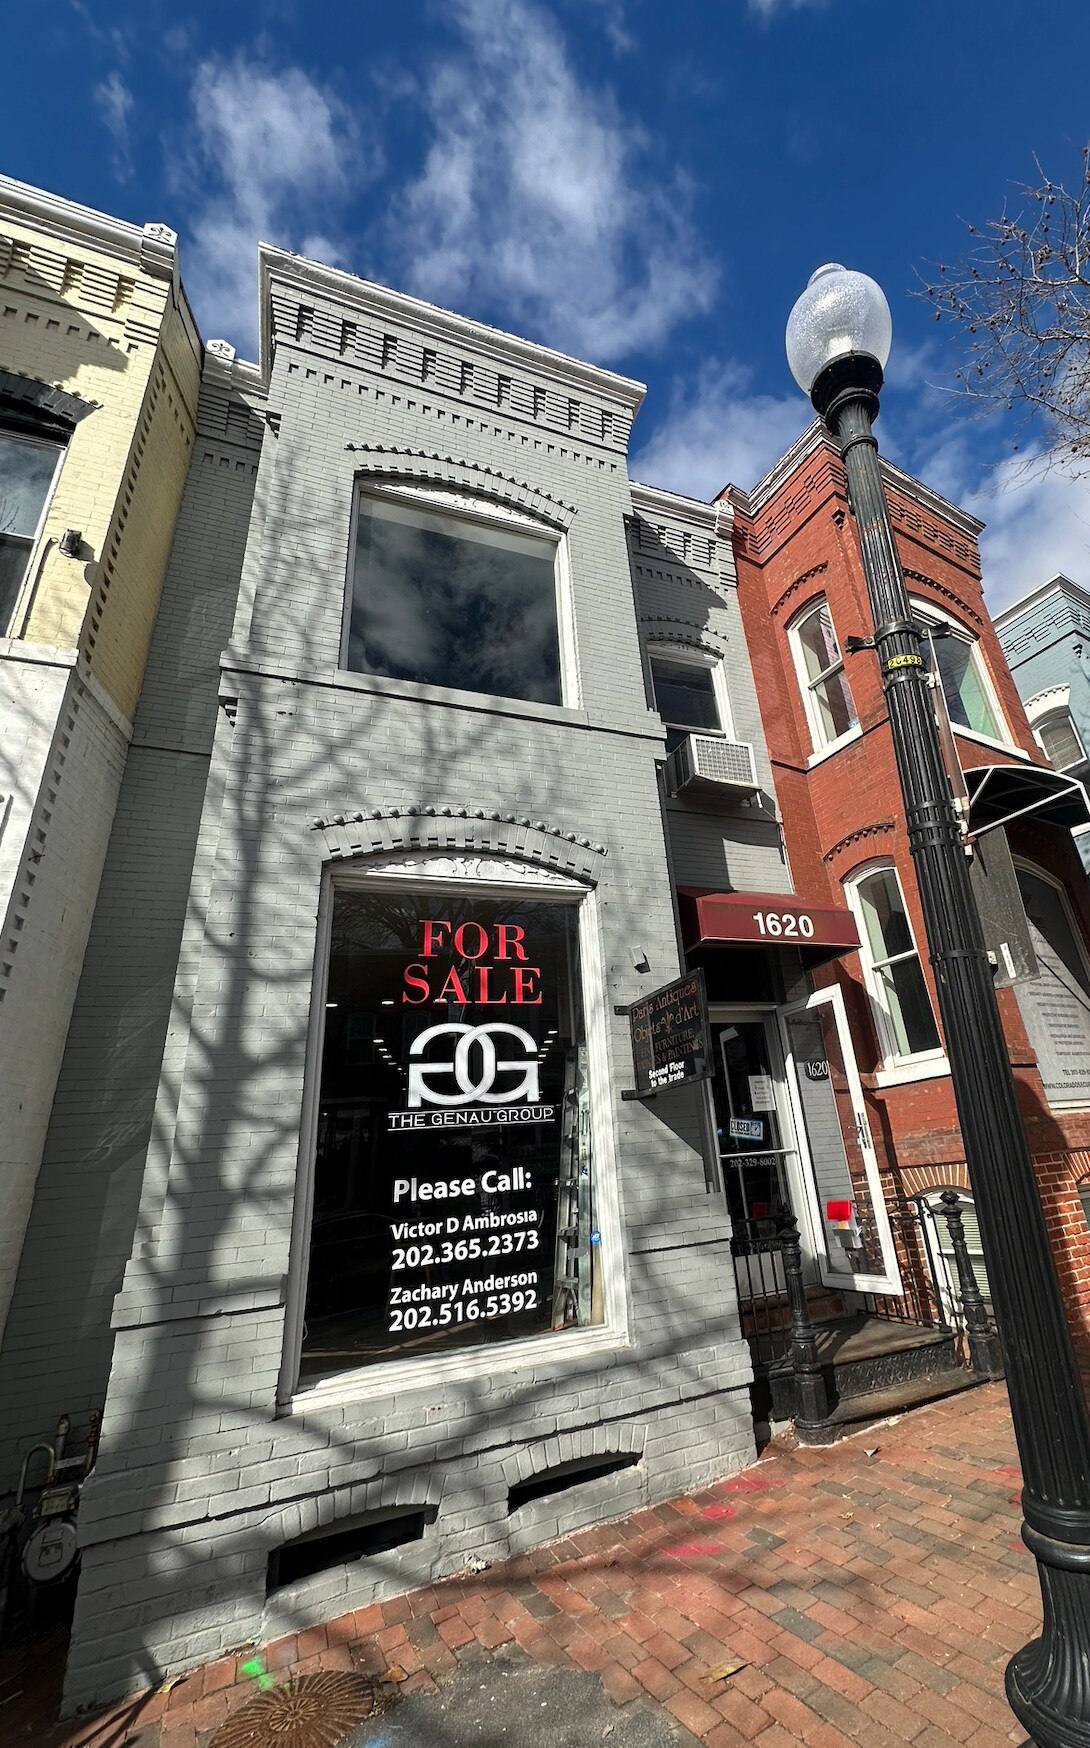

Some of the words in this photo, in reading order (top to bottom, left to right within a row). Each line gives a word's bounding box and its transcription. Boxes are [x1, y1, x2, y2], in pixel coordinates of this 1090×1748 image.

[418, 919, 529, 960] FOR
[753, 912, 815, 938] 1620
[402, 963, 543, 1004] SALE
[632, 1002, 654, 1022] Paris
[656, 981, 697, 1011] Antiques
[675, 1002, 699, 1024] d'Art
[648, 1064, 669, 1080] Second
[669, 1060, 685, 1073] Floor
[650, 1079, 658, 1088] to
[657, 1075, 668, 1086] the
[668, 1070, 685, 1082] trade
[807, 1060, 828, 1077] 1620
[388, 1113, 425, 1128] THE
[431, 1110, 492, 1126] GENAU
[496, 1107, 554, 1122] GROUP
[730, 1120, 750, 1132] CLOSED
[393, 1178, 476, 1203] Please
[481, 1166, 532, 1193] Call:
[390, 1221, 443, 1241] Victor
[446, 1217, 459, 1233] D
[462, 1209, 537, 1232] Ambrosia
[391, 1229, 539, 1271] 202.365.2373
[389, 1283, 459, 1305] Zachary
[462, 1271, 537, 1296] Anderson
[389, 1289, 537, 1332] 202.516.5392
